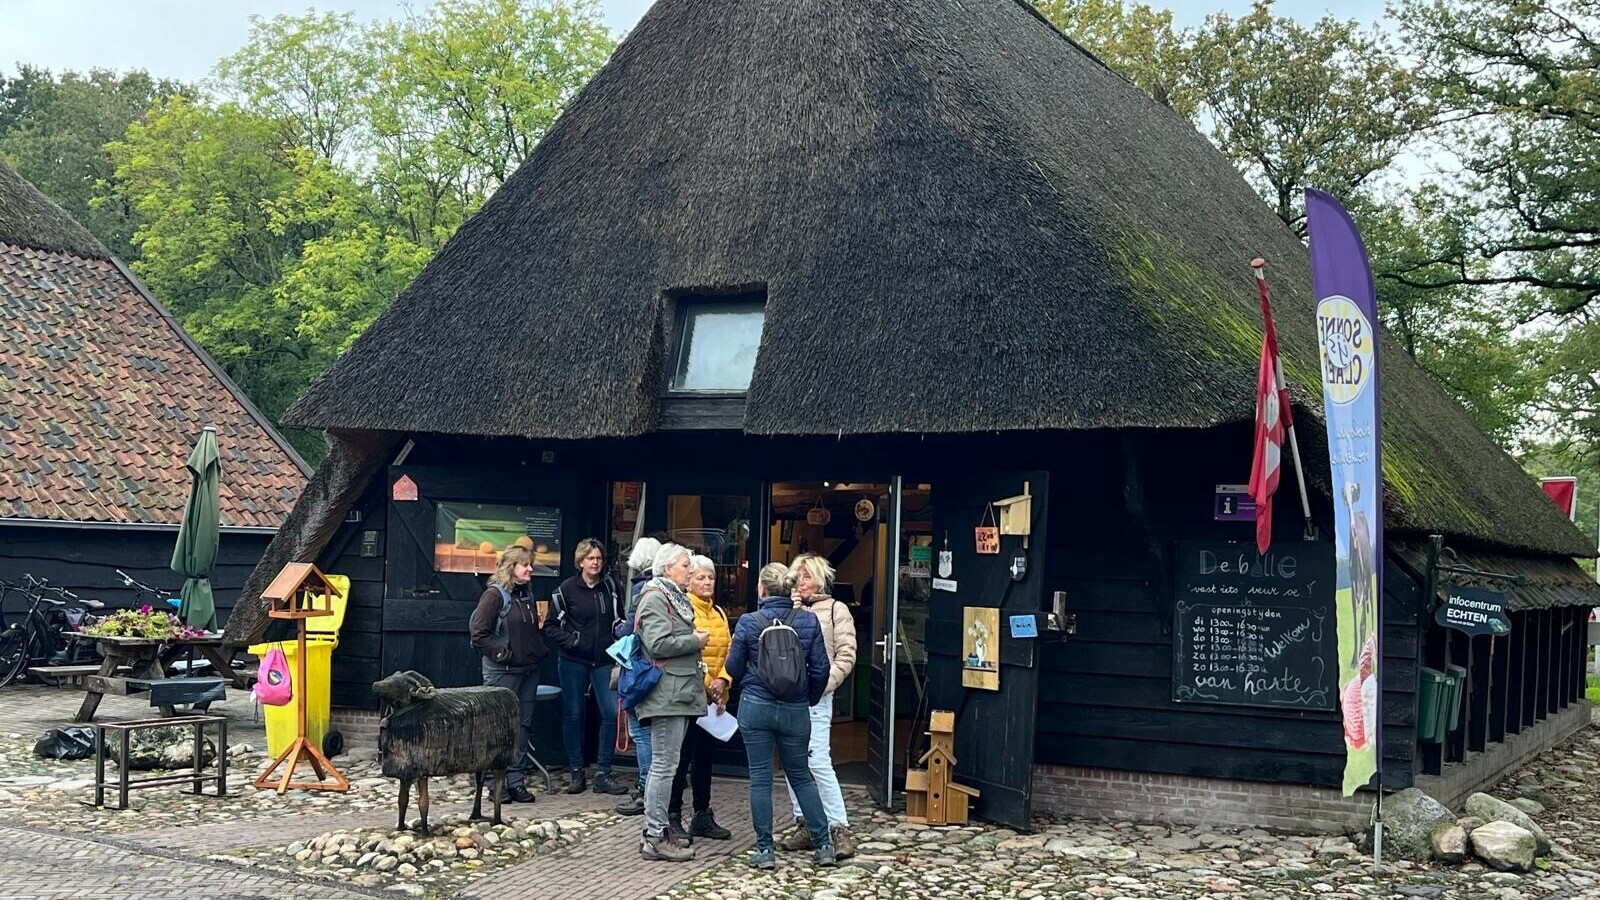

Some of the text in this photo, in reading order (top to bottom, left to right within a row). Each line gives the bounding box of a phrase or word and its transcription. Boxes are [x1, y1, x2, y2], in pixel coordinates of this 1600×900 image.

[1200, 550, 1230, 575] De
[1448, 594, 1501, 613] infocentrum
[1194, 616, 1204, 626] di
[1446, 608, 1488, 624] ECHTEN
[1193, 633, 1206, 642] do
[1264, 618, 1310, 660] Welkom
